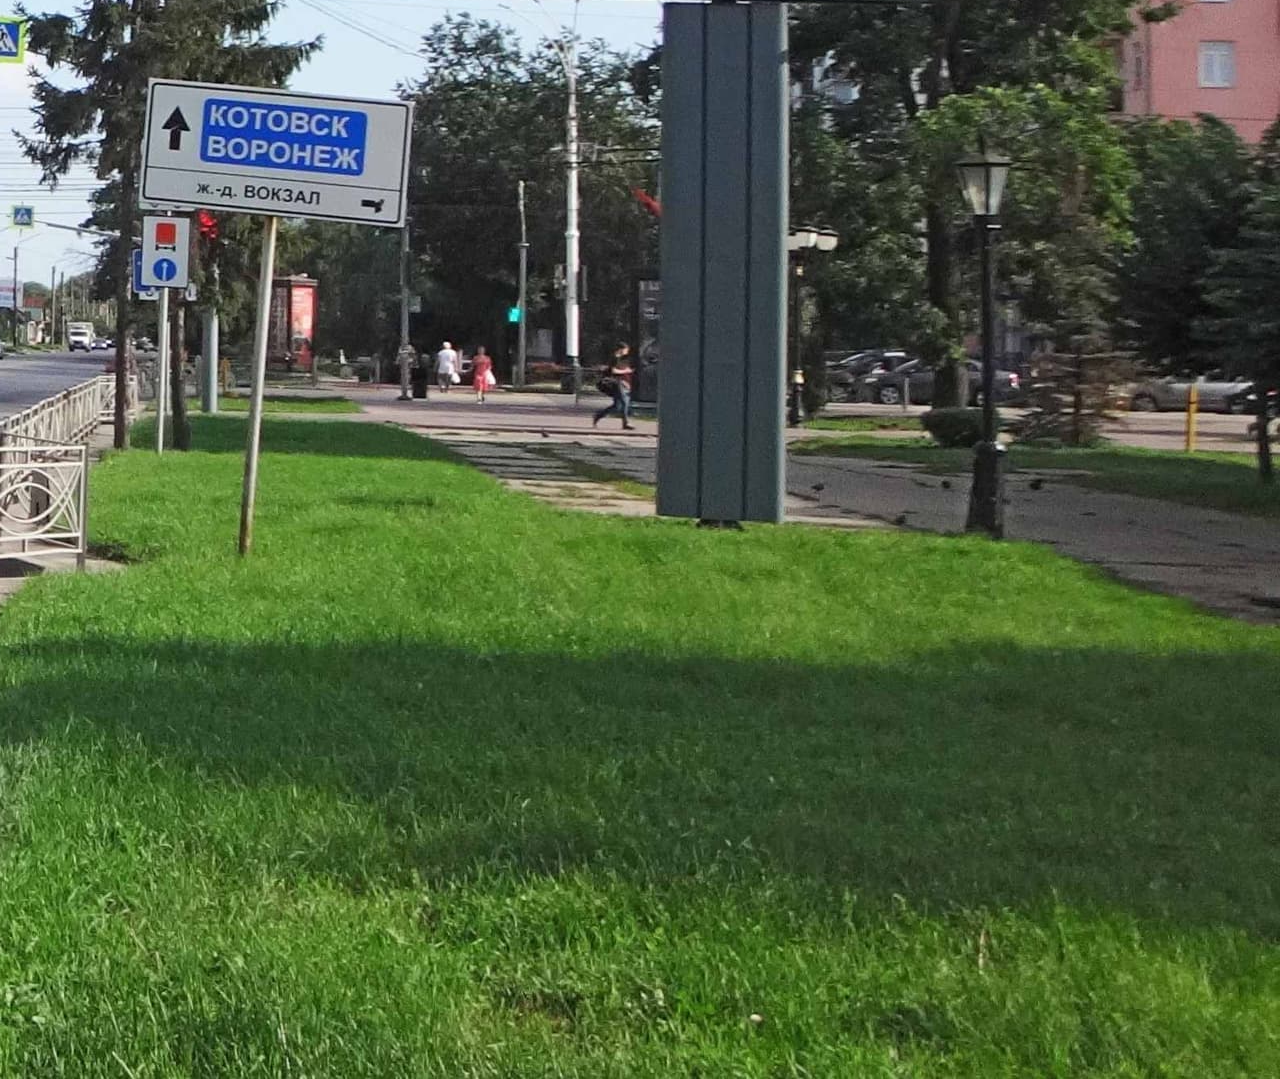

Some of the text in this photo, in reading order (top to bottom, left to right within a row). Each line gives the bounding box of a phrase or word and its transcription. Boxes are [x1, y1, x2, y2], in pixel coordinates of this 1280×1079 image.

[208, 104, 350, 139] КОТОВСК
[206, 135, 361, 171] ВОРОНЕЖ
[243, 184, 321, 206] ВОКЗАЛ
